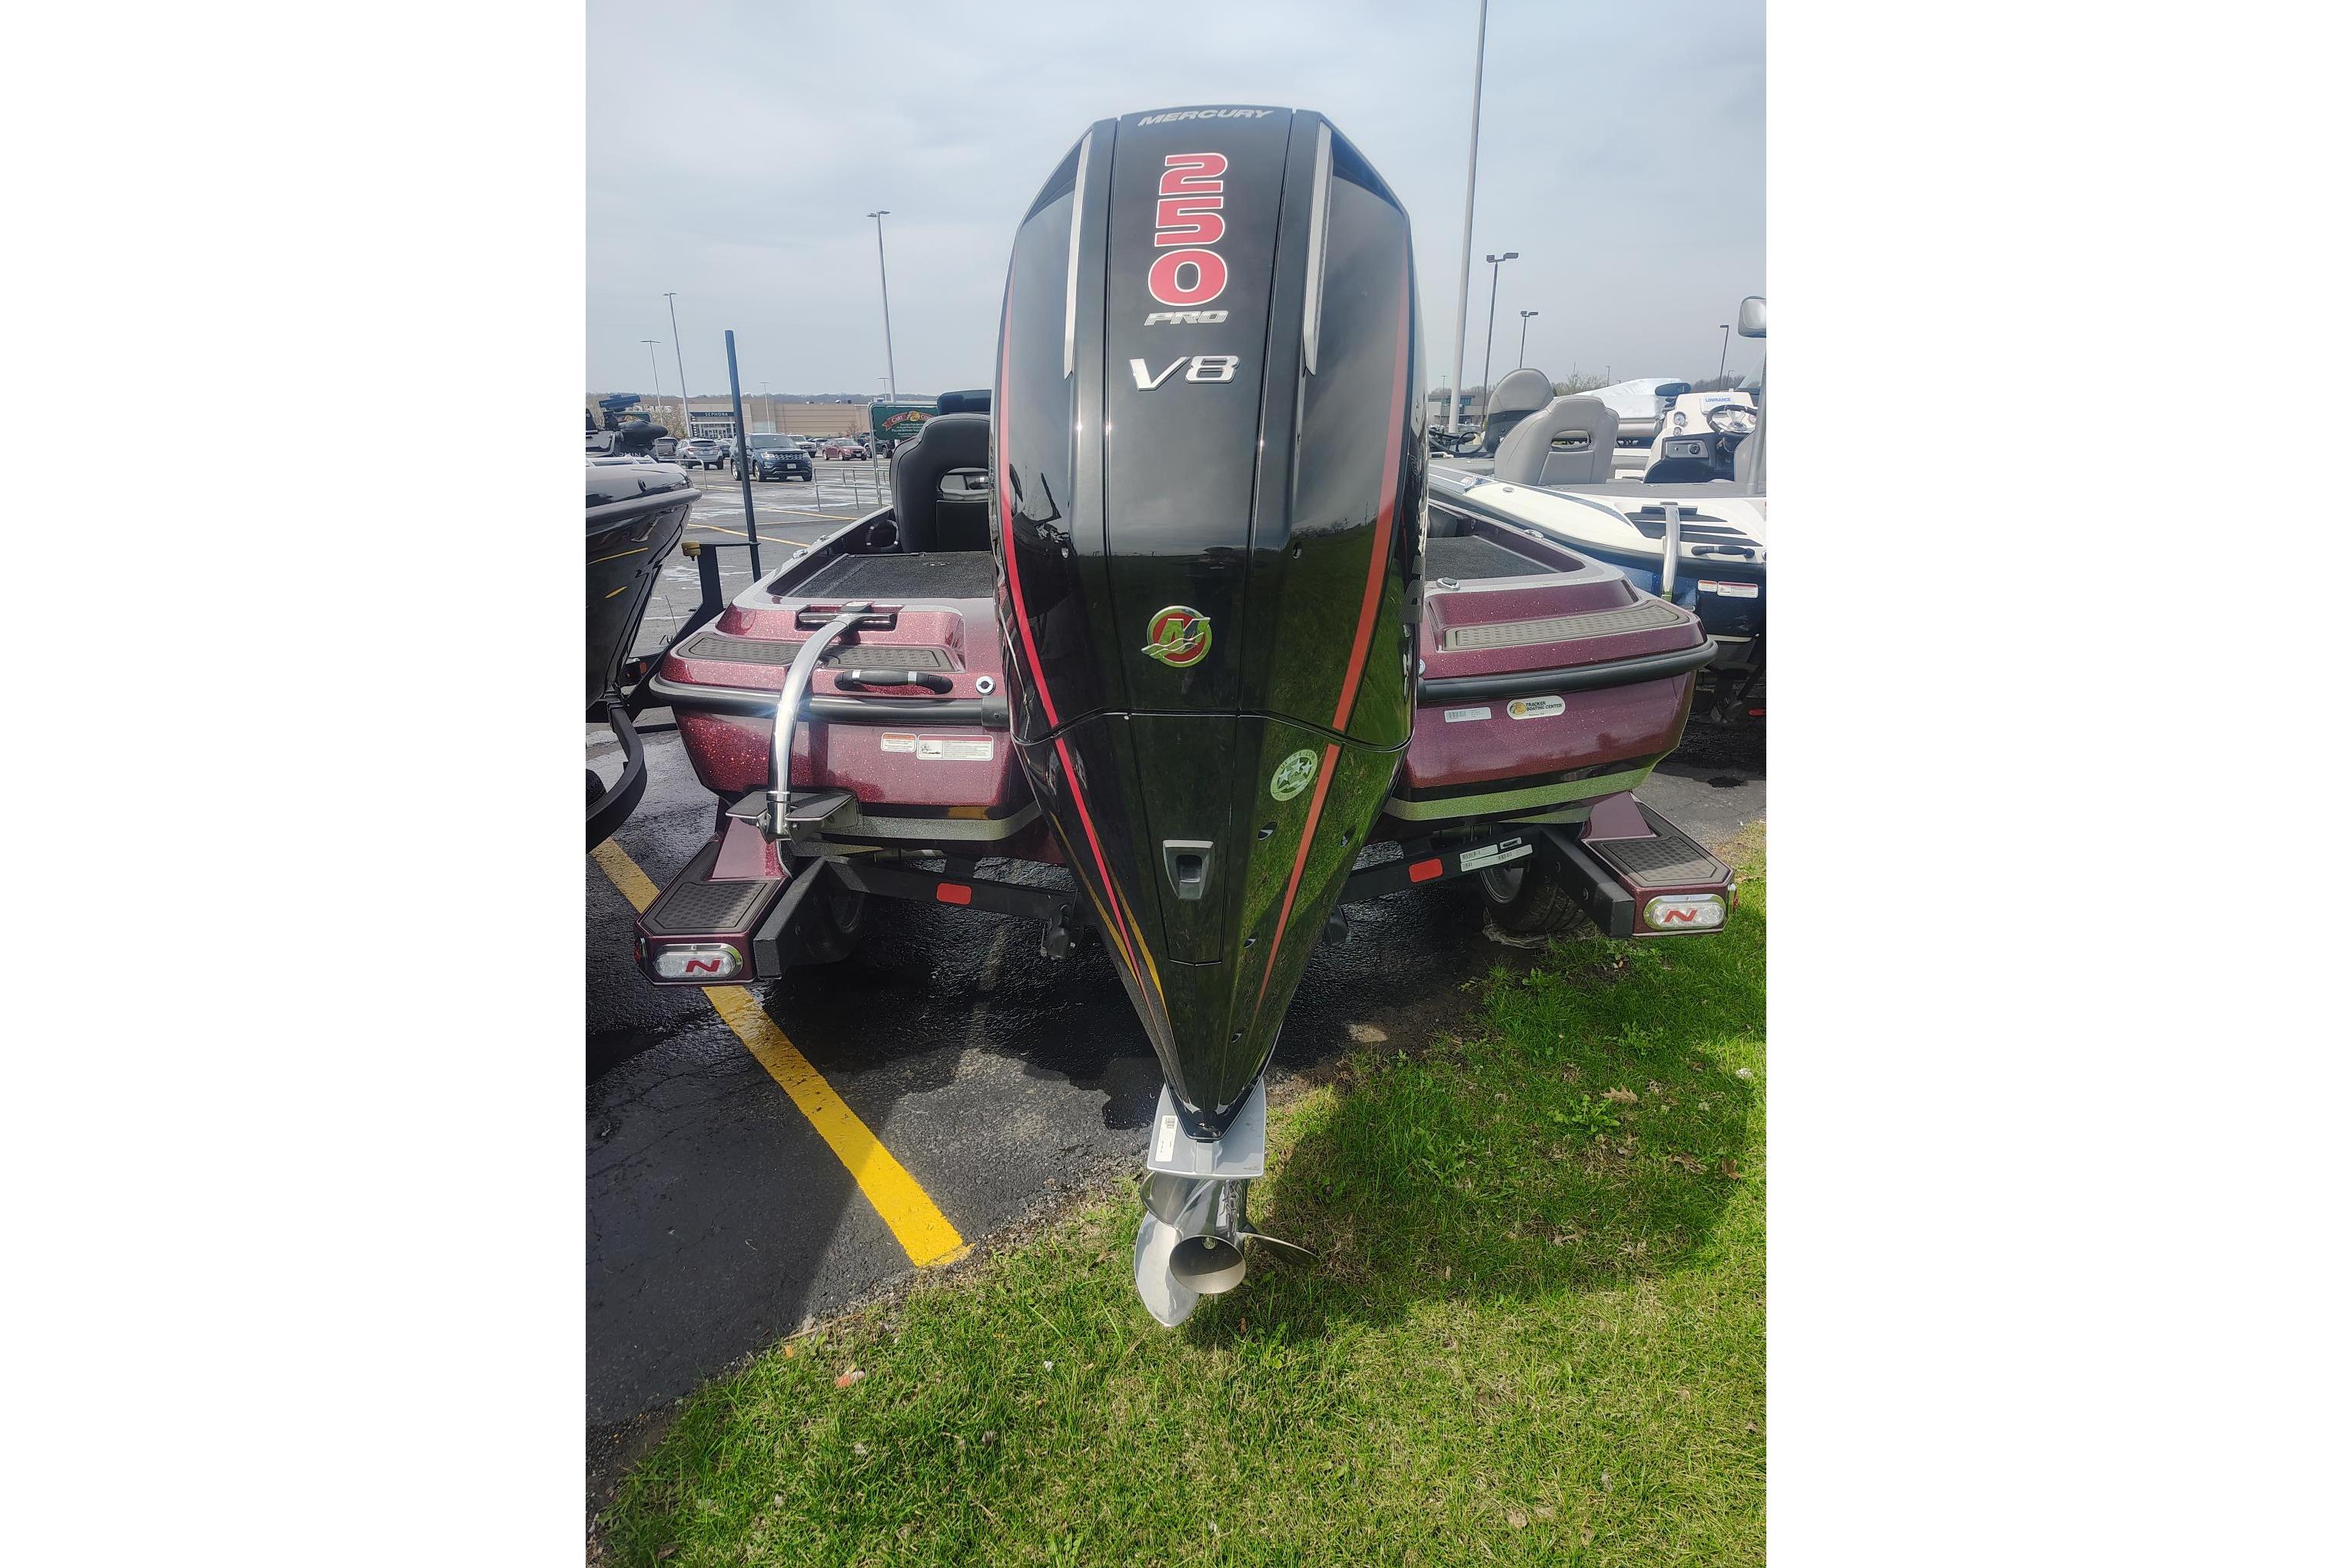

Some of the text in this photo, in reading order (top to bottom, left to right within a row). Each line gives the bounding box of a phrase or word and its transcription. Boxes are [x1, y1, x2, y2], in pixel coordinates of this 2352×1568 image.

[1138, 109, 1274, 127] MERCURY
[1148, 153, 1228, 307] 250
[1144, 310, 1229, 327] PRO
[1128, 355, 1240, 391] V8
